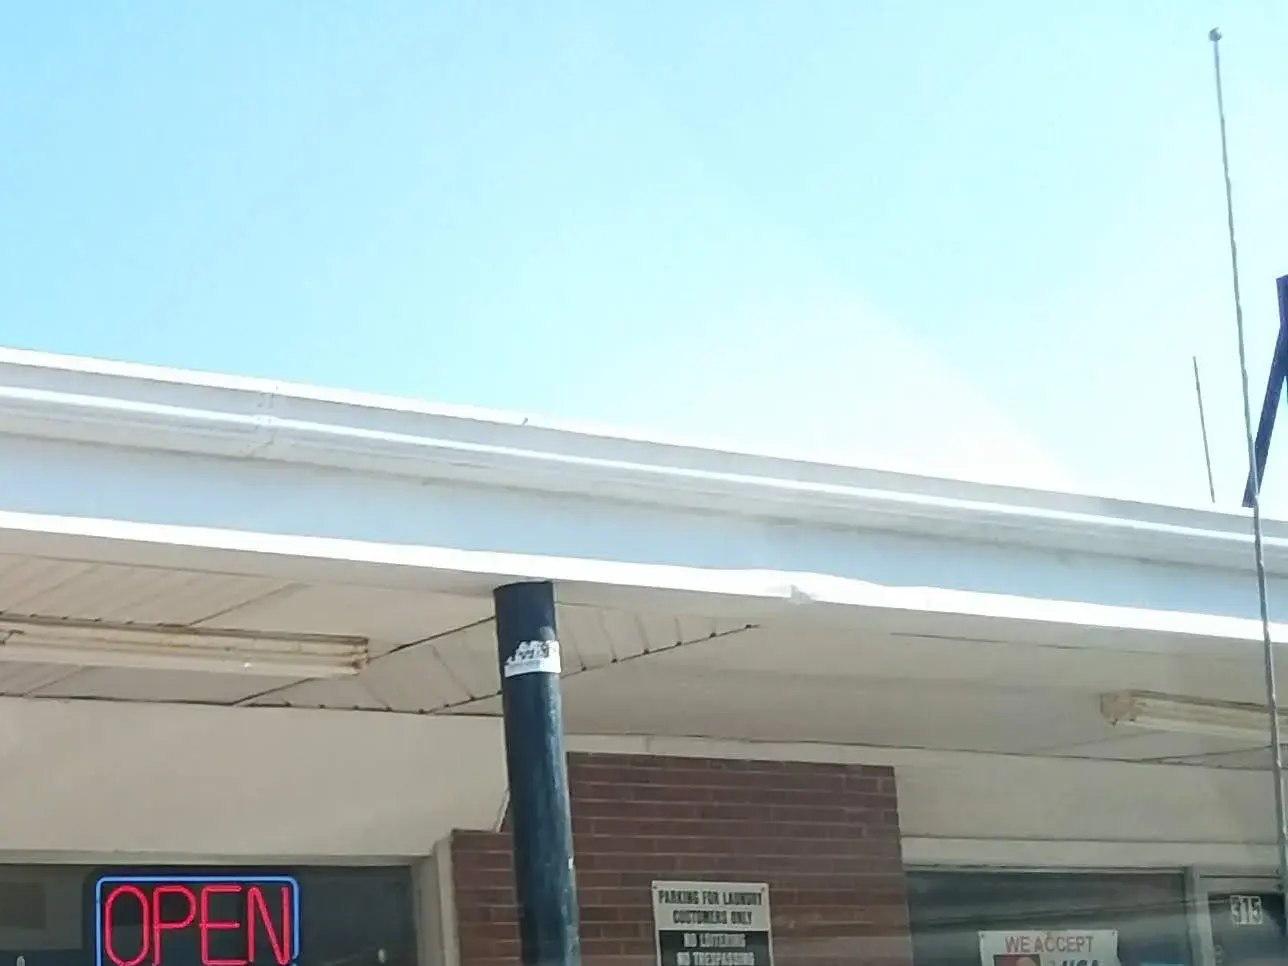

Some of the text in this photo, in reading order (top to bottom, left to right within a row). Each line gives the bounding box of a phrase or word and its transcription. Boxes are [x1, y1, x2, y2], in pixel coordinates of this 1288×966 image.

[658, 889, 762, 906] PARKING FOR LAUNDRY
[672, 909, 753, 925] CUSTOMERS ONLY
[1004, 935, 1094, 953] WE ACCEPT
